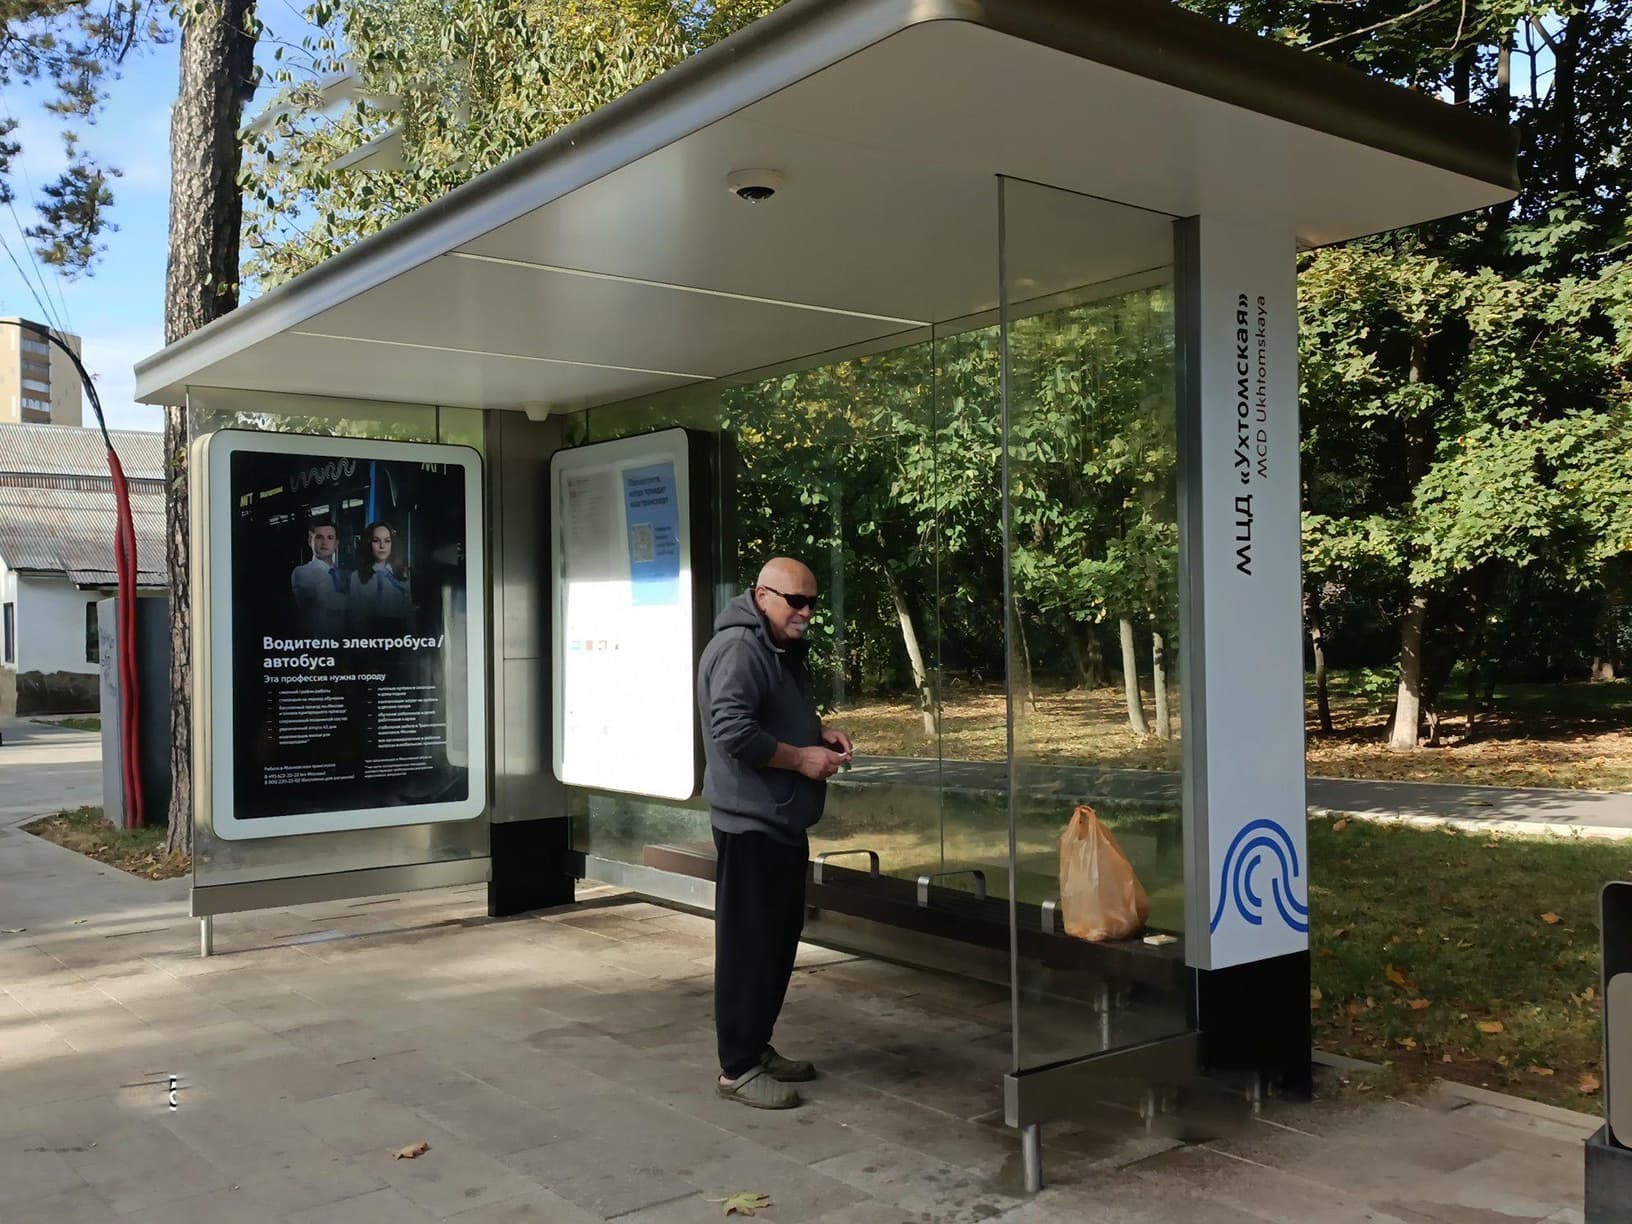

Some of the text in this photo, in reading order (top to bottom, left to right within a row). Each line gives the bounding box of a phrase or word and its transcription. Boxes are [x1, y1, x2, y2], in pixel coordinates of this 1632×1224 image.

[1255, 295, 1268, 479] MCD Ukhtomskaya
[1234, 293, 1254, 576] МЦД «Ухтомская»
[263, 634, 444, 651] Водитель электробуса/
[263, 654, 335, 670] автобуса
[263, 673, 386, 684] Эта профессия нужна городу
